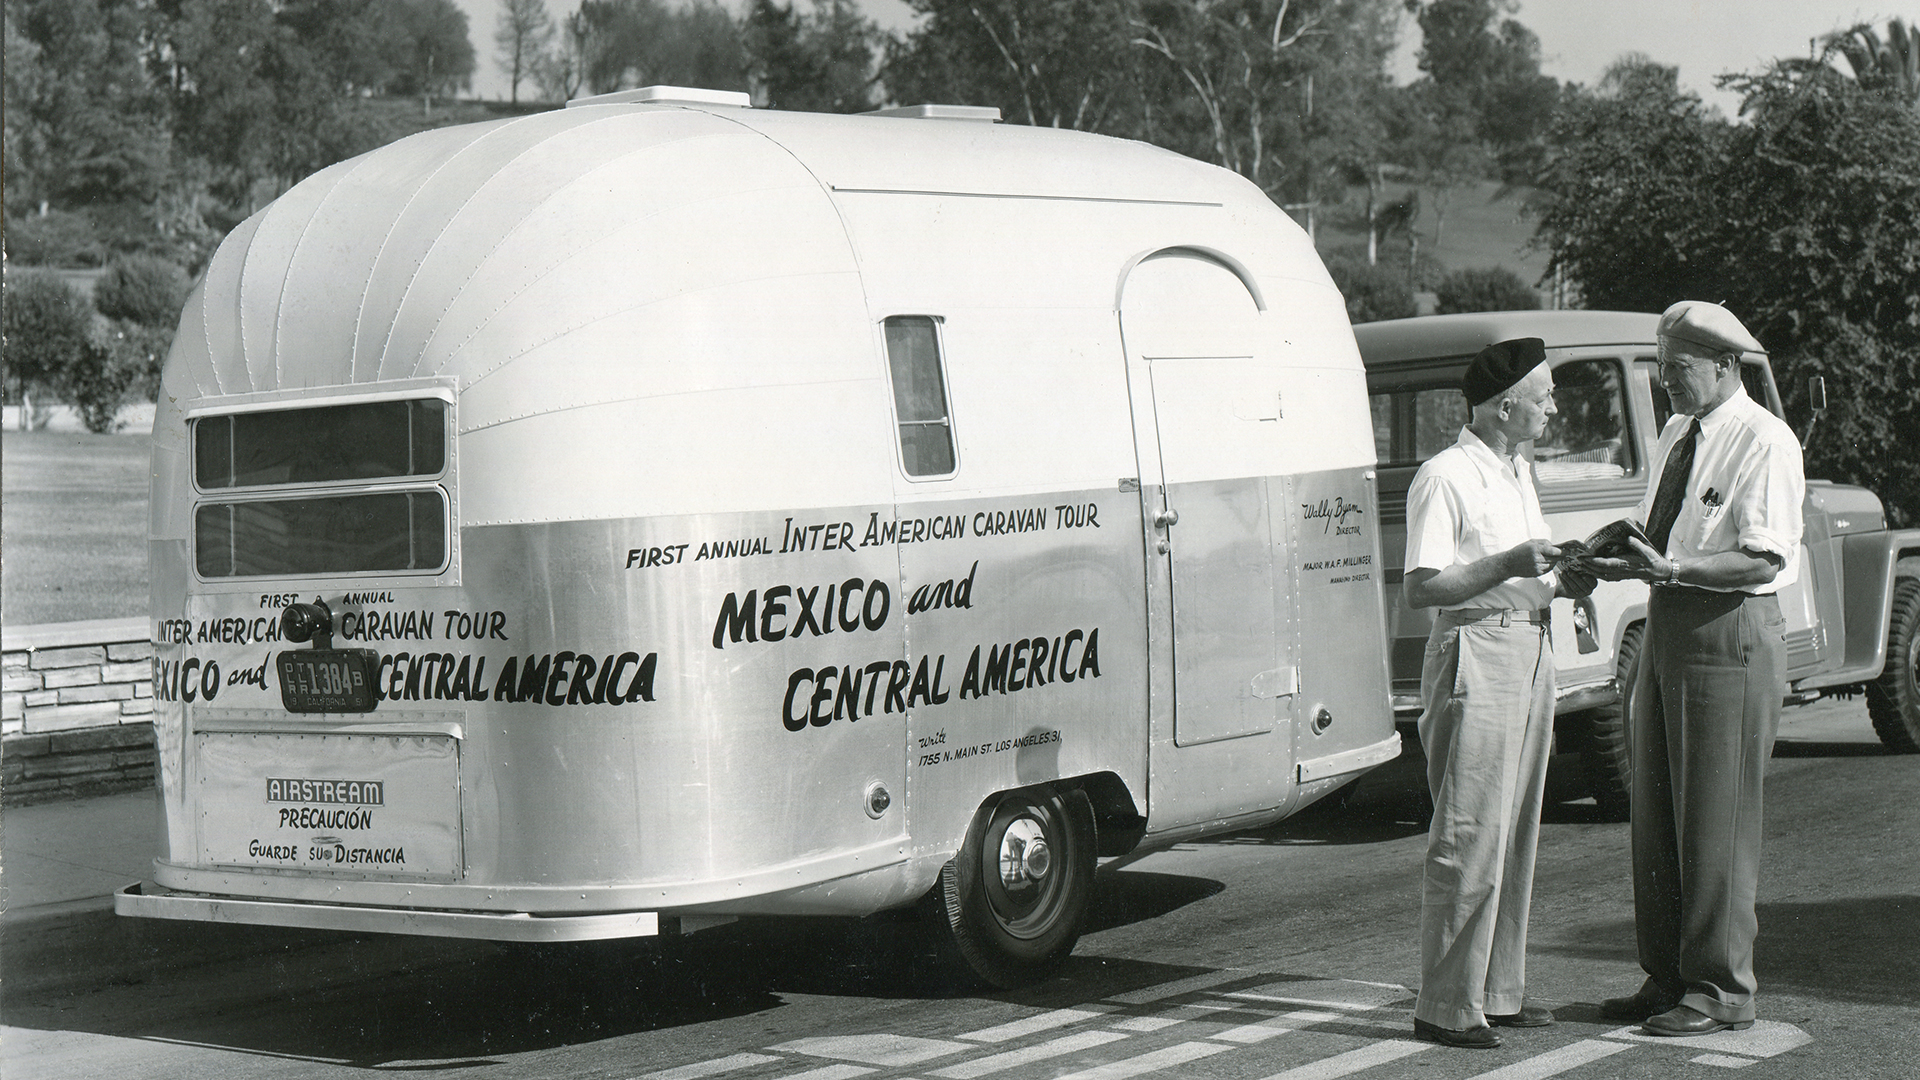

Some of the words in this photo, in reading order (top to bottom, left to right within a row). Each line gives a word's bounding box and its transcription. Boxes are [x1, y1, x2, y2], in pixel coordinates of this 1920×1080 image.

[1301, 499, 1334, 535] Wally
[1333, 496, 1363, 525] Byam
[625, 543, 690, 569] FIRST
[694, 537, 773, 561] ANNUAL
[973, 507, 1047, 537] CARAVAN
[1055, 503, 1100, 530] TOUR
[1335, 525, 1362, 536] DIRECTOR
[1302, 561, 1323, 571] MAJOR
[260, 593, 299, 608] FIRST
[343, 591, 395, 605] ANNUAL
[712, 577, 891, 650] MEXICO
[907, 559, 979, 615] and
[158, 619, 193, 645] INTER
[198, 616, 282, 645] AMERICA
[341, 610, 434, 641] CARAVAN
[444, 611, 509, 640] TOUR
[153, 656, 220, 703] EXICO
[227, 651, 272, 691] and
[376, 651, 489, 702] CENTRAL
[494, 651, 657, 706] AMERICA
[307, 662, 353, 695] 1384
[782, 653, 950, 732] CENTRAL
[959, 627, 1102, 700] AMERICA
[307, 697, 346, 706] CALIFORNIA
[918, 752, 941, 767] 1755
[980, 743, 992, 755] ST.
[995, 740, 1011, 753] LOS
[270, 780, 380, 804] AIRSTREAM
[279, 806, 373, 830] PRECAUCIÓN
[249, 839, 298, 861] GUARDE
[309, 846, 323, 860] SU
[334, 844, 406, 864] DISTANCIA
